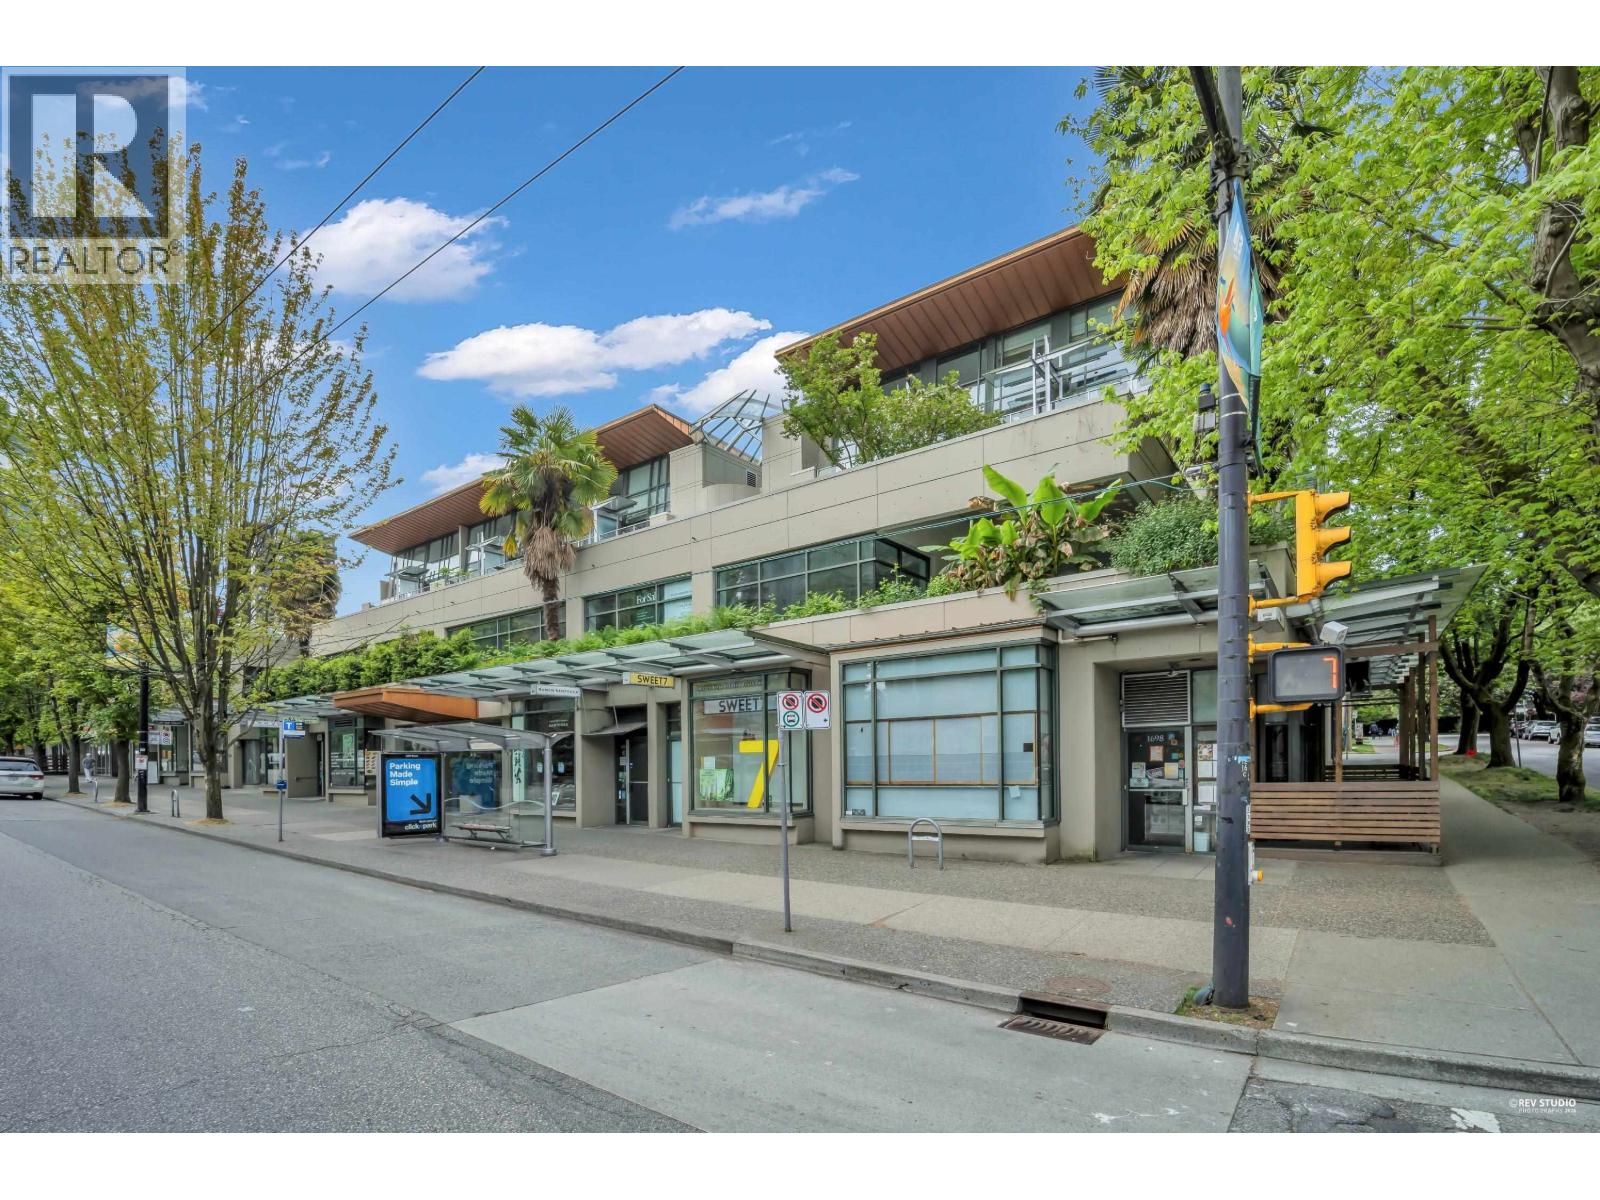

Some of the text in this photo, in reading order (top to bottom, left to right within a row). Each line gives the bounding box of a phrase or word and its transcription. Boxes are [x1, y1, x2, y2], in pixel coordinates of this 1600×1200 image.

[1322, 656, 1339, 690] 7
[637, 675, 668, 685] SWEET7
[719, 697, 760, 713] SWEET
[389, 762, 421, 770] Parking
[389, 770, 413, 778] Made
[739, 739, 779, 809] 7
[389, 778, 419, 787] Simple
